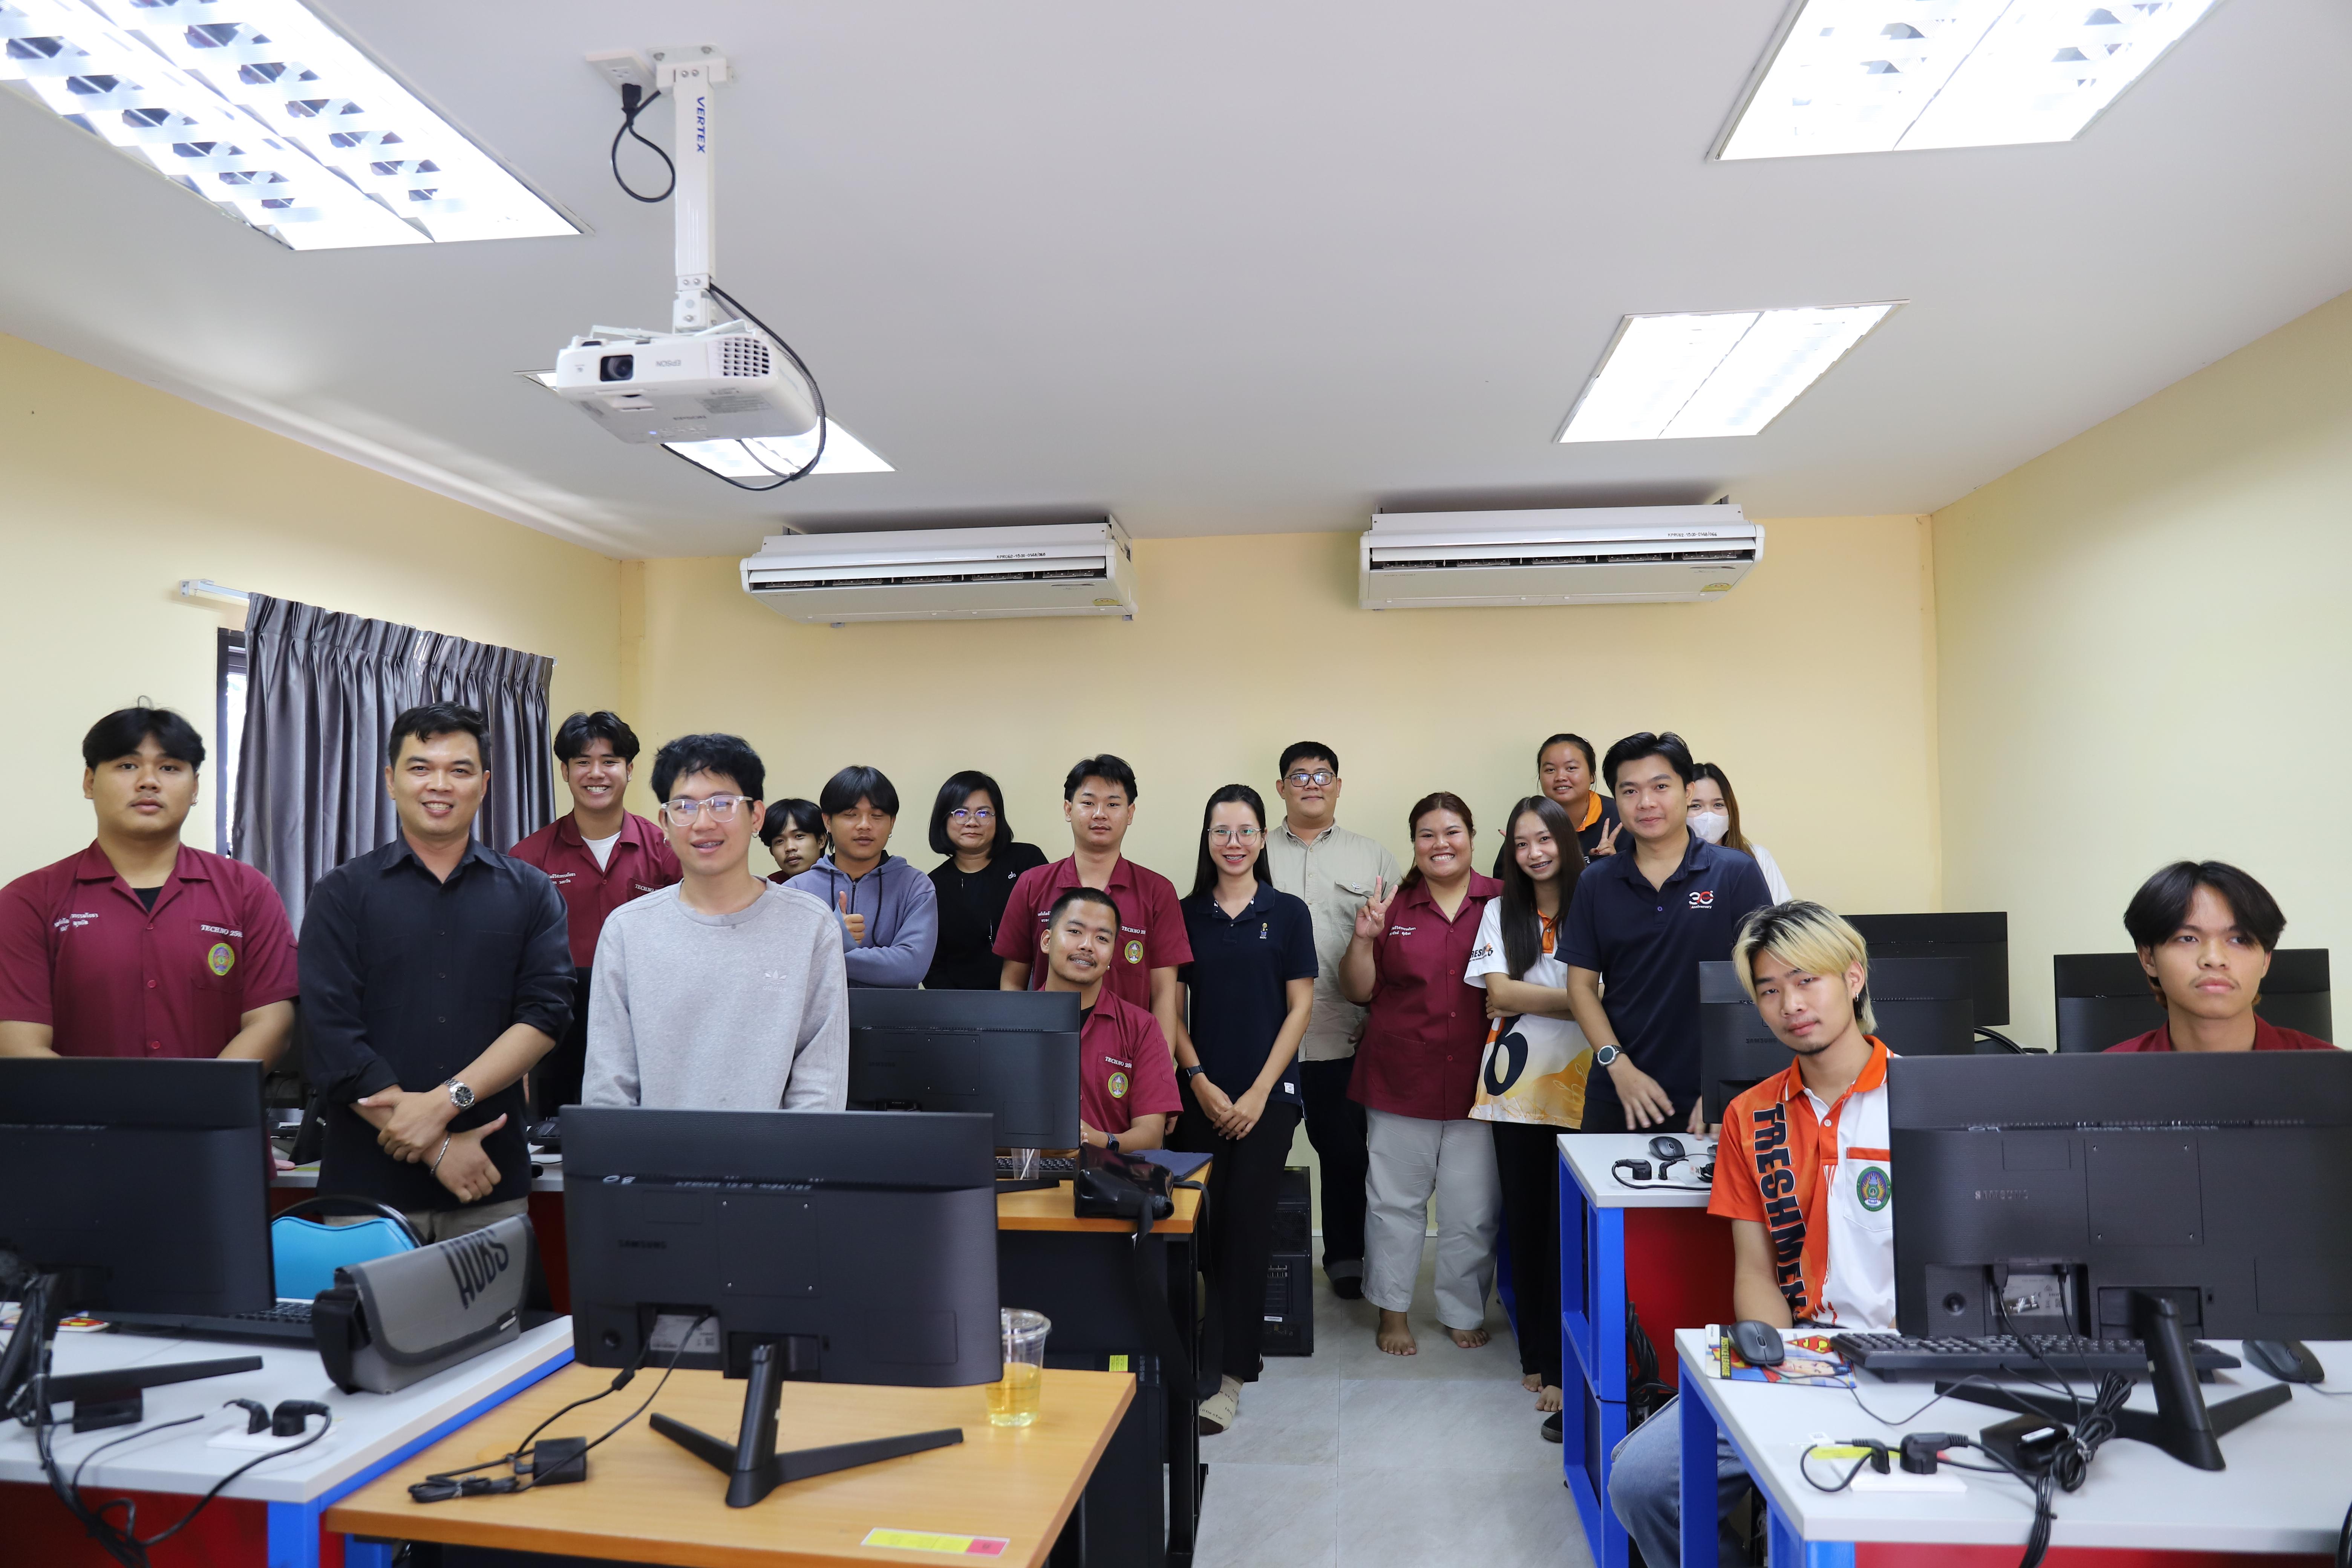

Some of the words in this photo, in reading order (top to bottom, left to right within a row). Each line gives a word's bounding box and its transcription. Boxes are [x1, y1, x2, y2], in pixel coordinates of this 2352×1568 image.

[697, 96, 706, 153] VERTEX
[635, 884, 654, 892] TECHNO
[201, 924, 229, 935] TECHNO
[1105, 1056, 1124, 1066] TECHNO
[603, 1175, 636, 1185] 08
[1721, 1336, 1729, 1356] JUSTICE
[1721, 1356, 1730, 1377] LEAGUE
